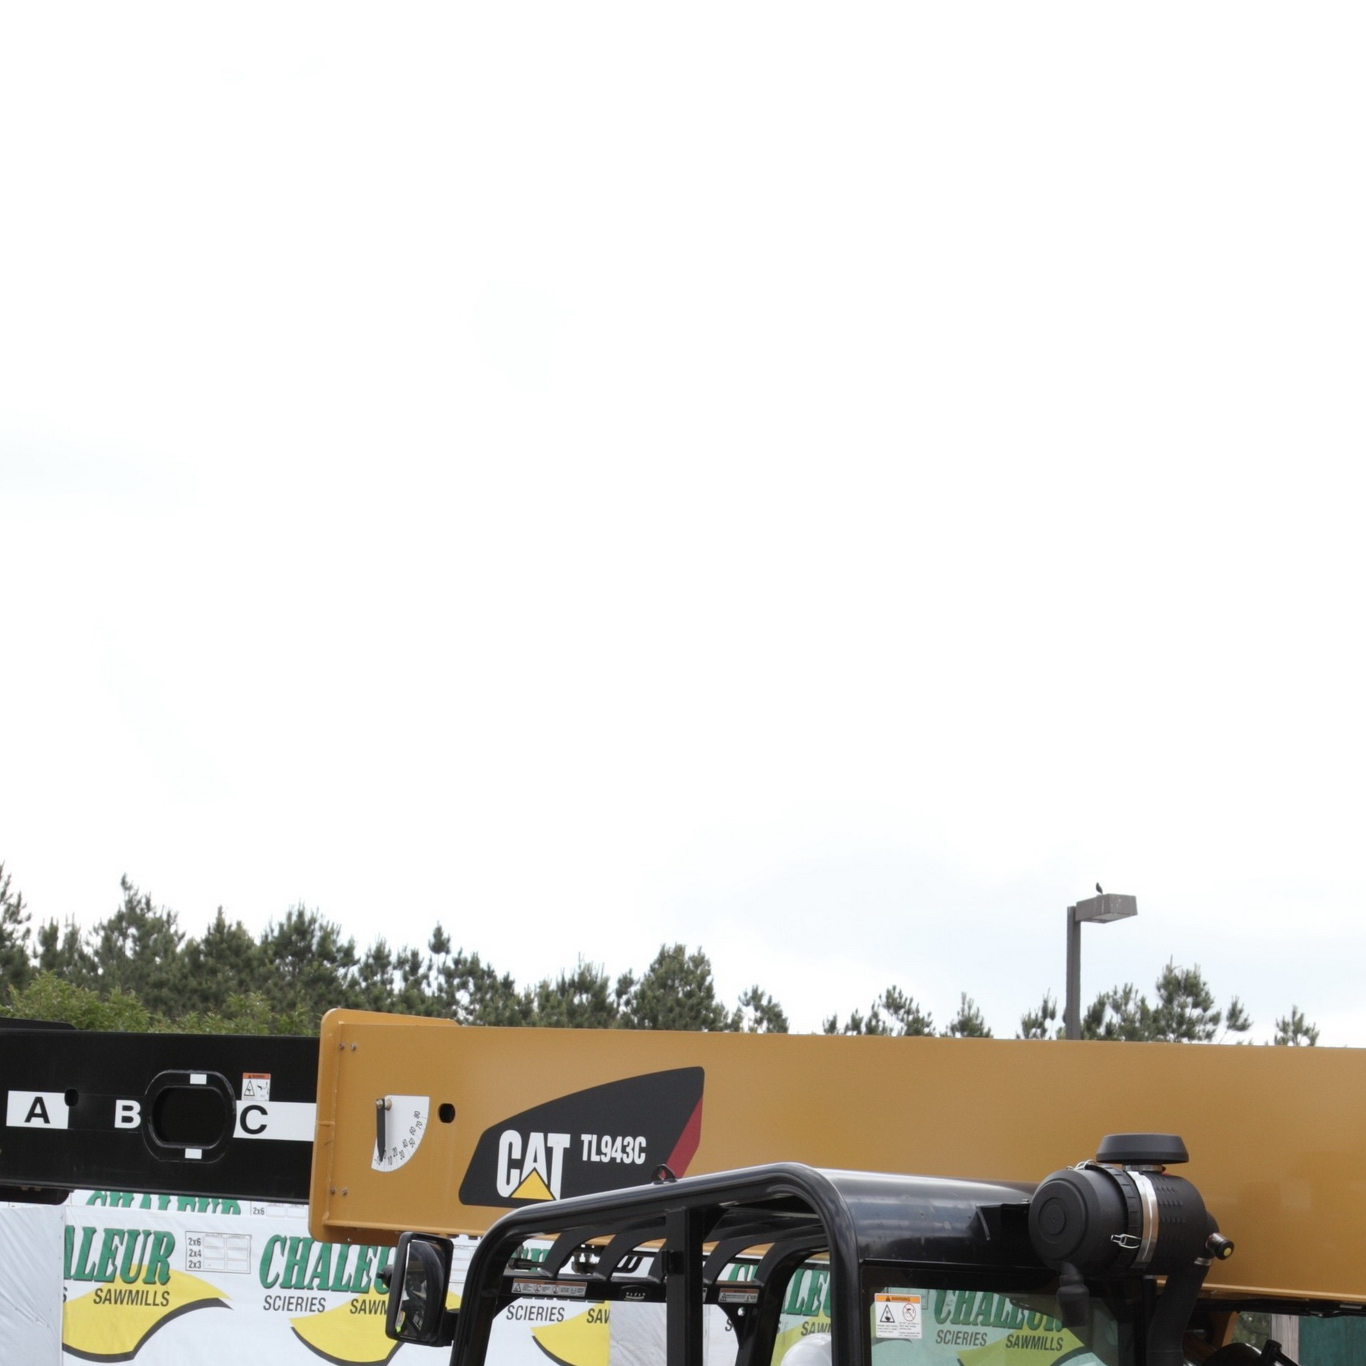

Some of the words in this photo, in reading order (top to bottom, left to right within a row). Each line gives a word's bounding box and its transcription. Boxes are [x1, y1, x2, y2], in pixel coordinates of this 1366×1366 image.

[24, 1097, 51, 1124] A
[114, 1100, 142, 1129] B
[240, 1105, 268, 1134] C
[497, 1130, 570, 1200] CAT
[581, 1134, 646, 1165] TL943C
[253, 1207, 265, 1215] 2x6
[188, 1238, 201, 1246] 2x6
[188, 1249, 202, 1257] 2x4
[188, 1260, 202, 1269] 2x3
[93, 1288, 170, 1307] SAWMILLS
[263, 1295, 326, 1313] SCIERIES
[506, 1305, 565, 1323] SCIERIES
[936, 1330, 987, 1347] SCIERIES
[1006, 1334, 1064, 1351] SAWMILLS
